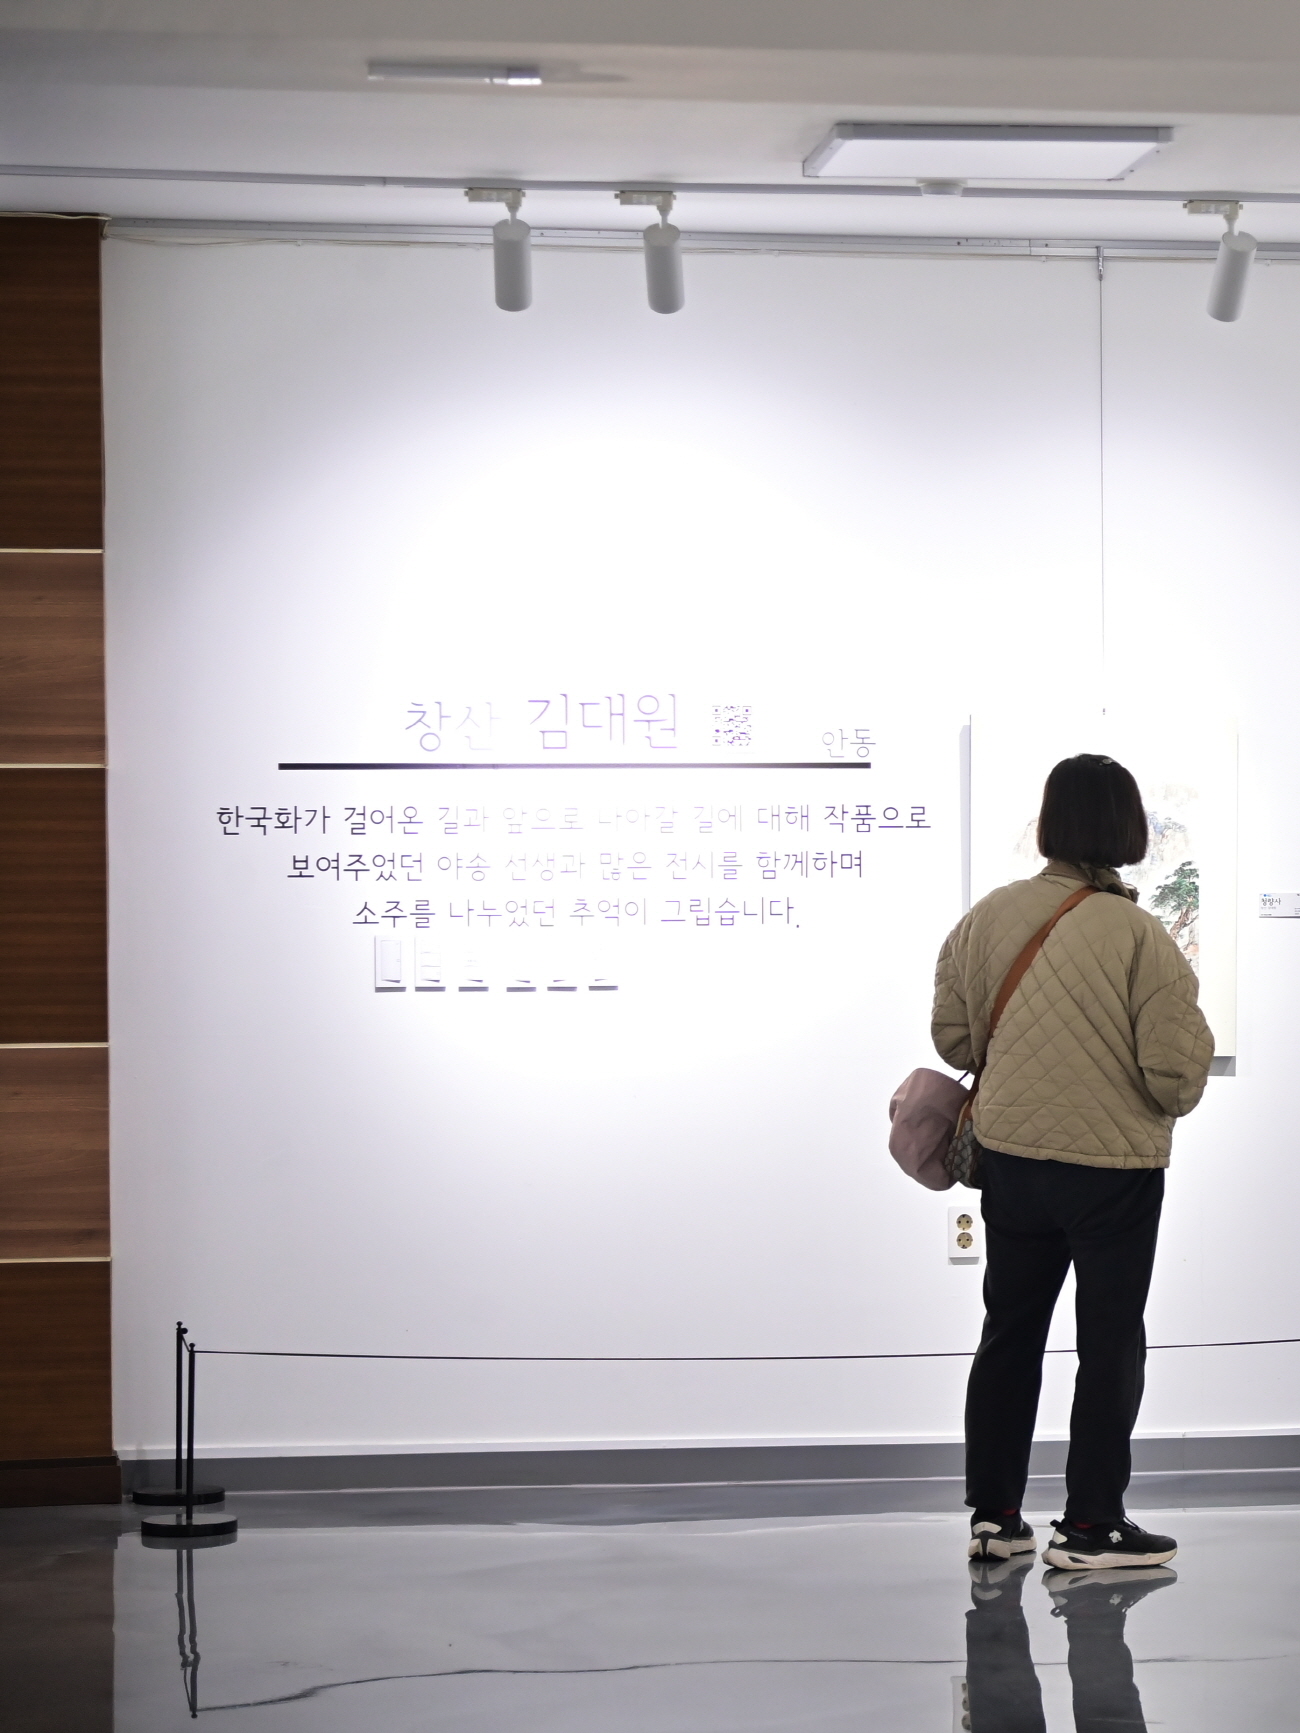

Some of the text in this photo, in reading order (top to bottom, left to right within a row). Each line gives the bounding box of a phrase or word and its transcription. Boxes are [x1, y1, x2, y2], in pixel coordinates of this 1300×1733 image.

[404, 693, 877, 758] 창산 김대원 안동
[215, 803, 932, 836] 한국화가 걸어온 길과 앞으로 나아갈 길에 대해 작품으로
[286, 849, 863, 882] 보여주었던 야송 선생과 많은 전시를 함께하며
[352, 896, 801, 929] 소주를 나누었던 추억이 그립습니다.
